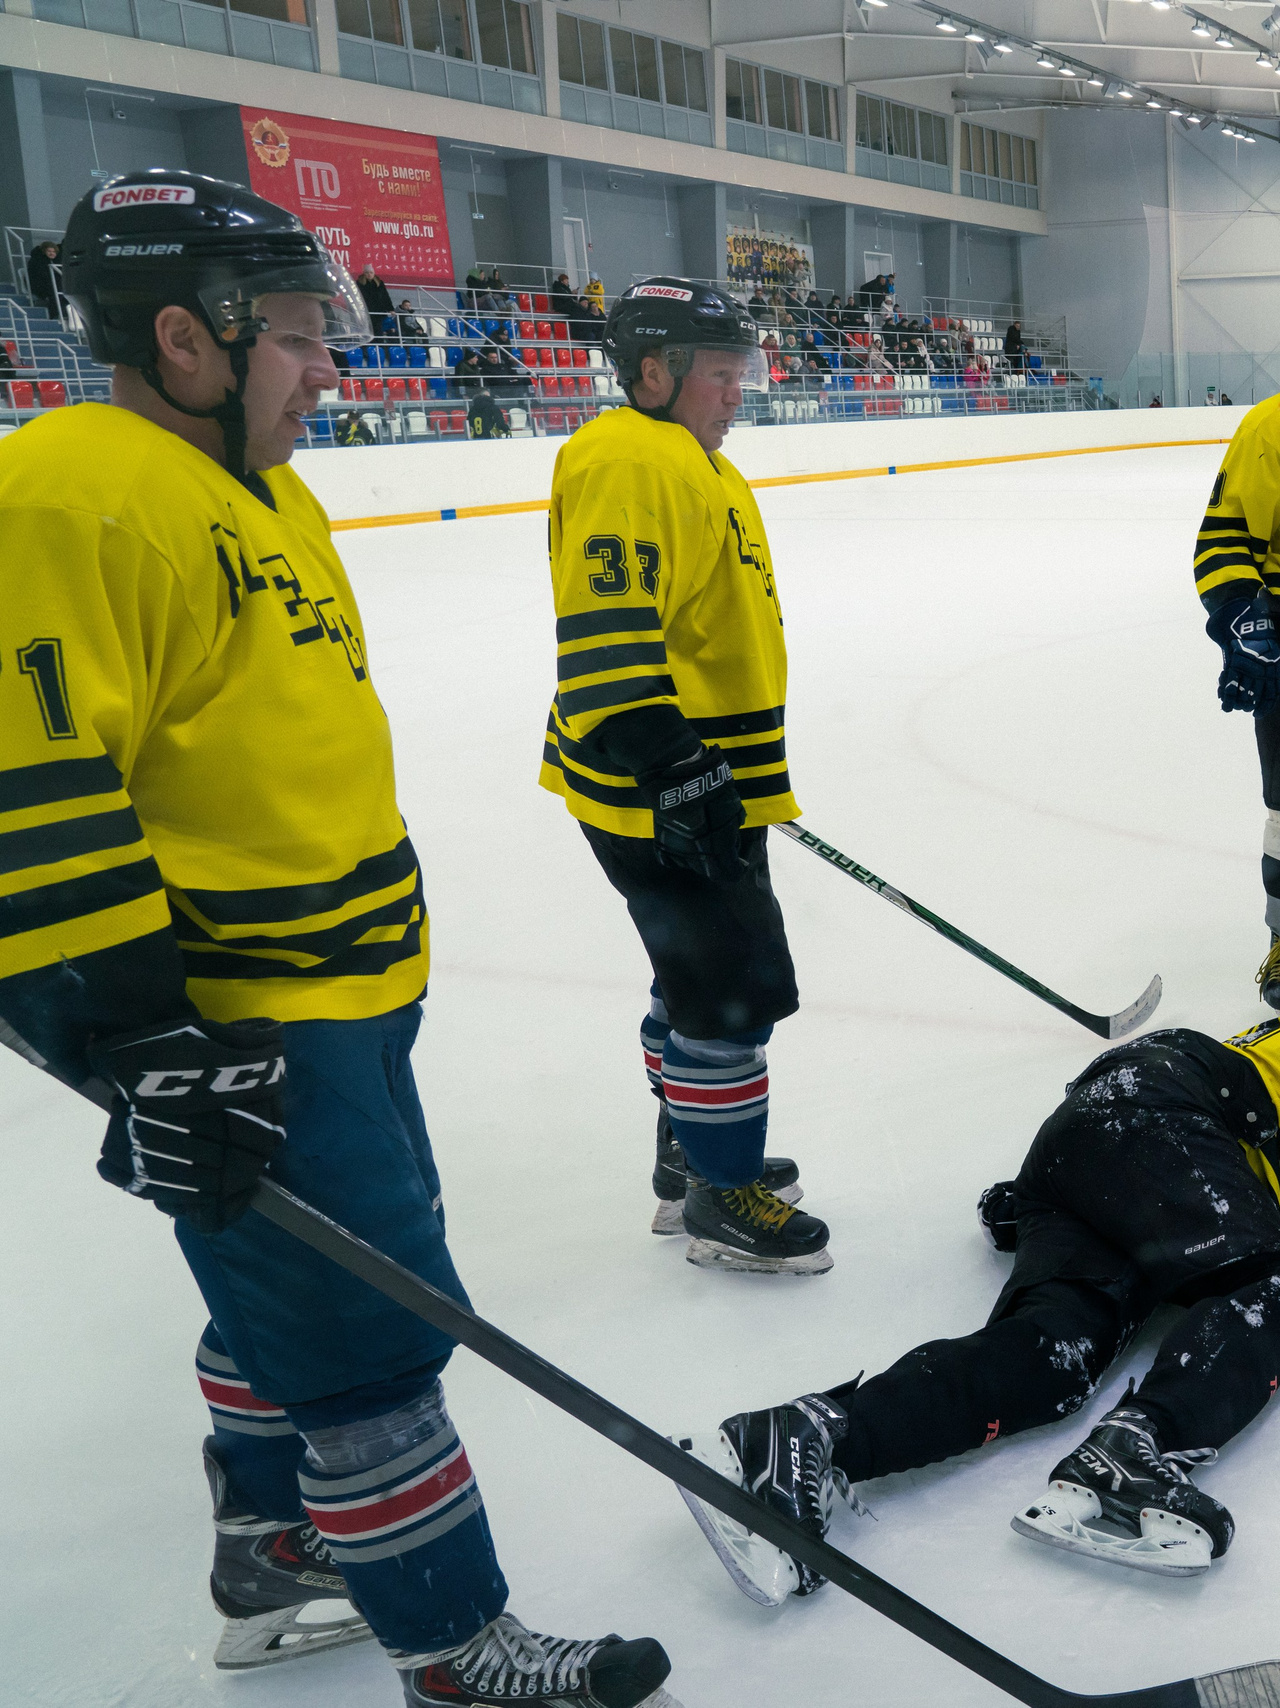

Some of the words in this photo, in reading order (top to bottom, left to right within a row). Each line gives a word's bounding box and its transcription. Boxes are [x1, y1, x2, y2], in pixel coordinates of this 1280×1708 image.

[294, 158, 341, 199] ГТО
[362, 158, 390, 179] Будь
[392, 166, 432, 183] вместе
[99, 188, 189, 208] FONBET
[378, 180, 386, 194] с
[387, 182, 421, 197] нами!
[373, 220, 434, 239] www.gto.ru
[640, 287, 689, 299] FONBET
[635, 327, 668, 335] CCM
[473, 417, 482, 435] 8
[790, 1436, 802, 1483] CCM
